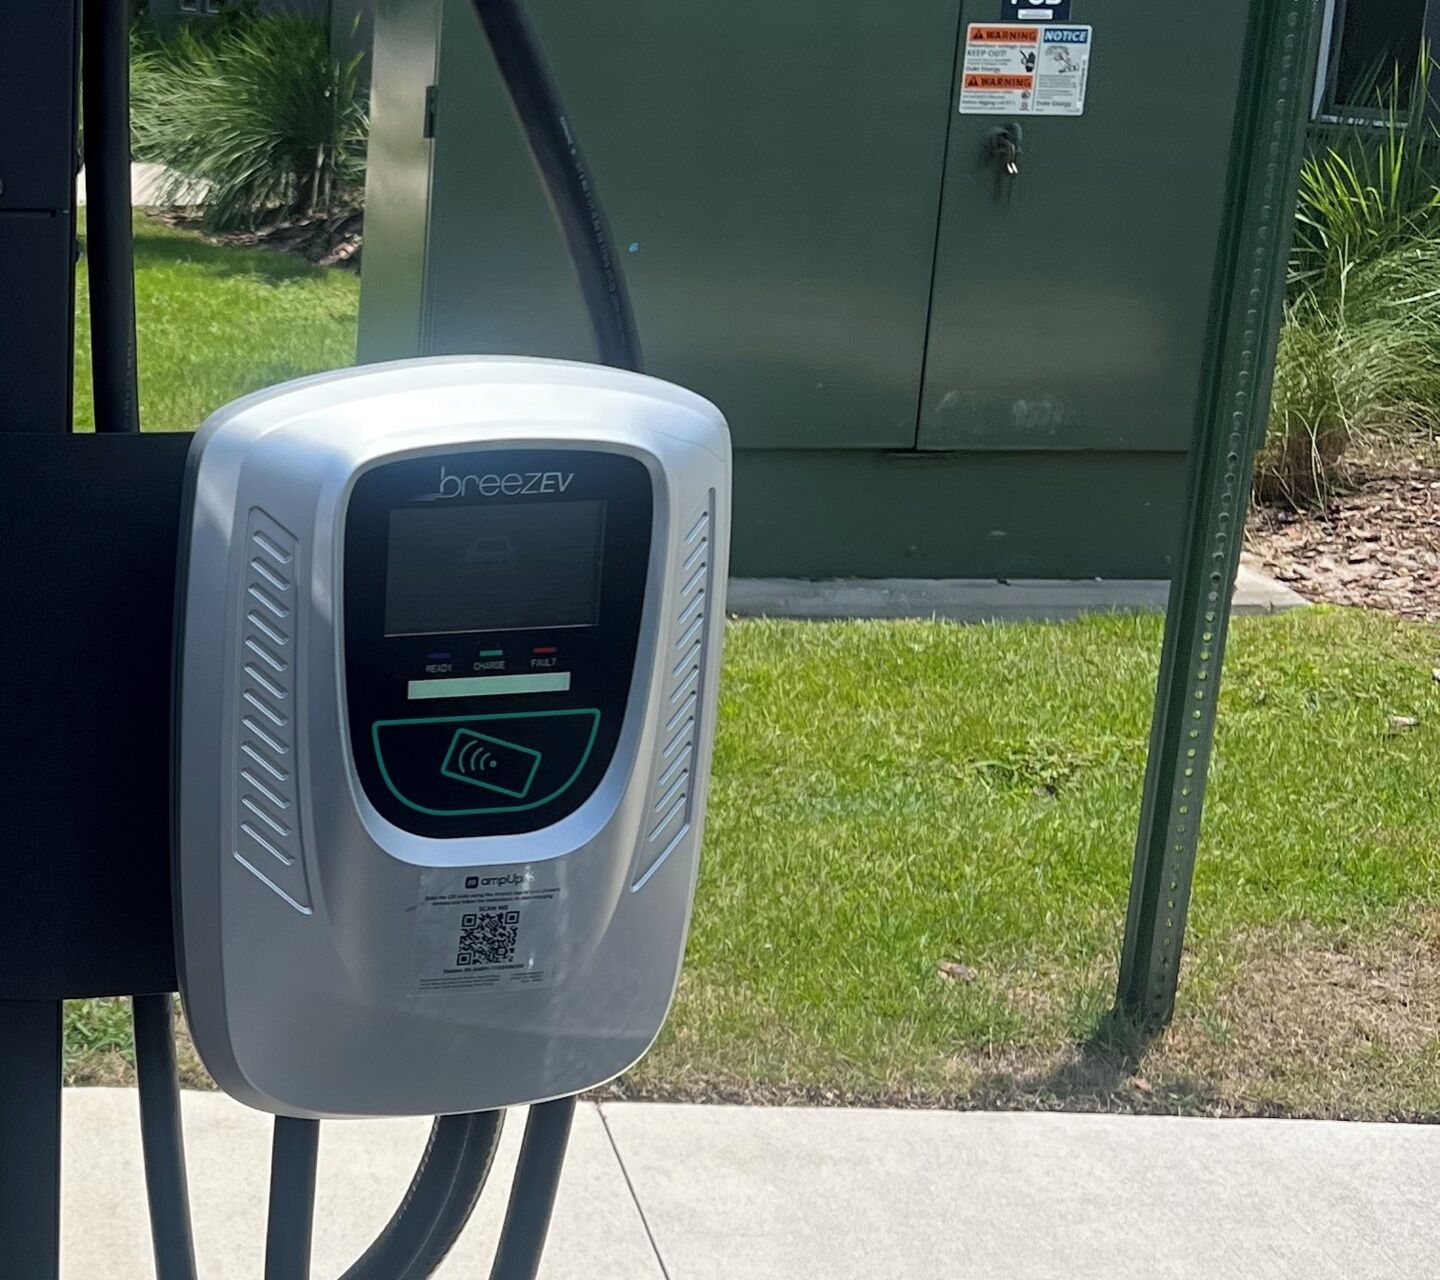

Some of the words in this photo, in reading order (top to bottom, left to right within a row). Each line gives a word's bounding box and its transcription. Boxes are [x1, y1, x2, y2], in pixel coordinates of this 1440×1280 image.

[986, 30, 1037, 40] WARNING
[1044, 30, 1087, 41] NOTICE
[980, 77, 1031, 87] WARNING
[439, 466, 575, 499] breezEV
[472, 659, 507, 672] CHARGE
[530, 657, 558, 668] FAULT
[481, 874, 524, 886] ampUp
